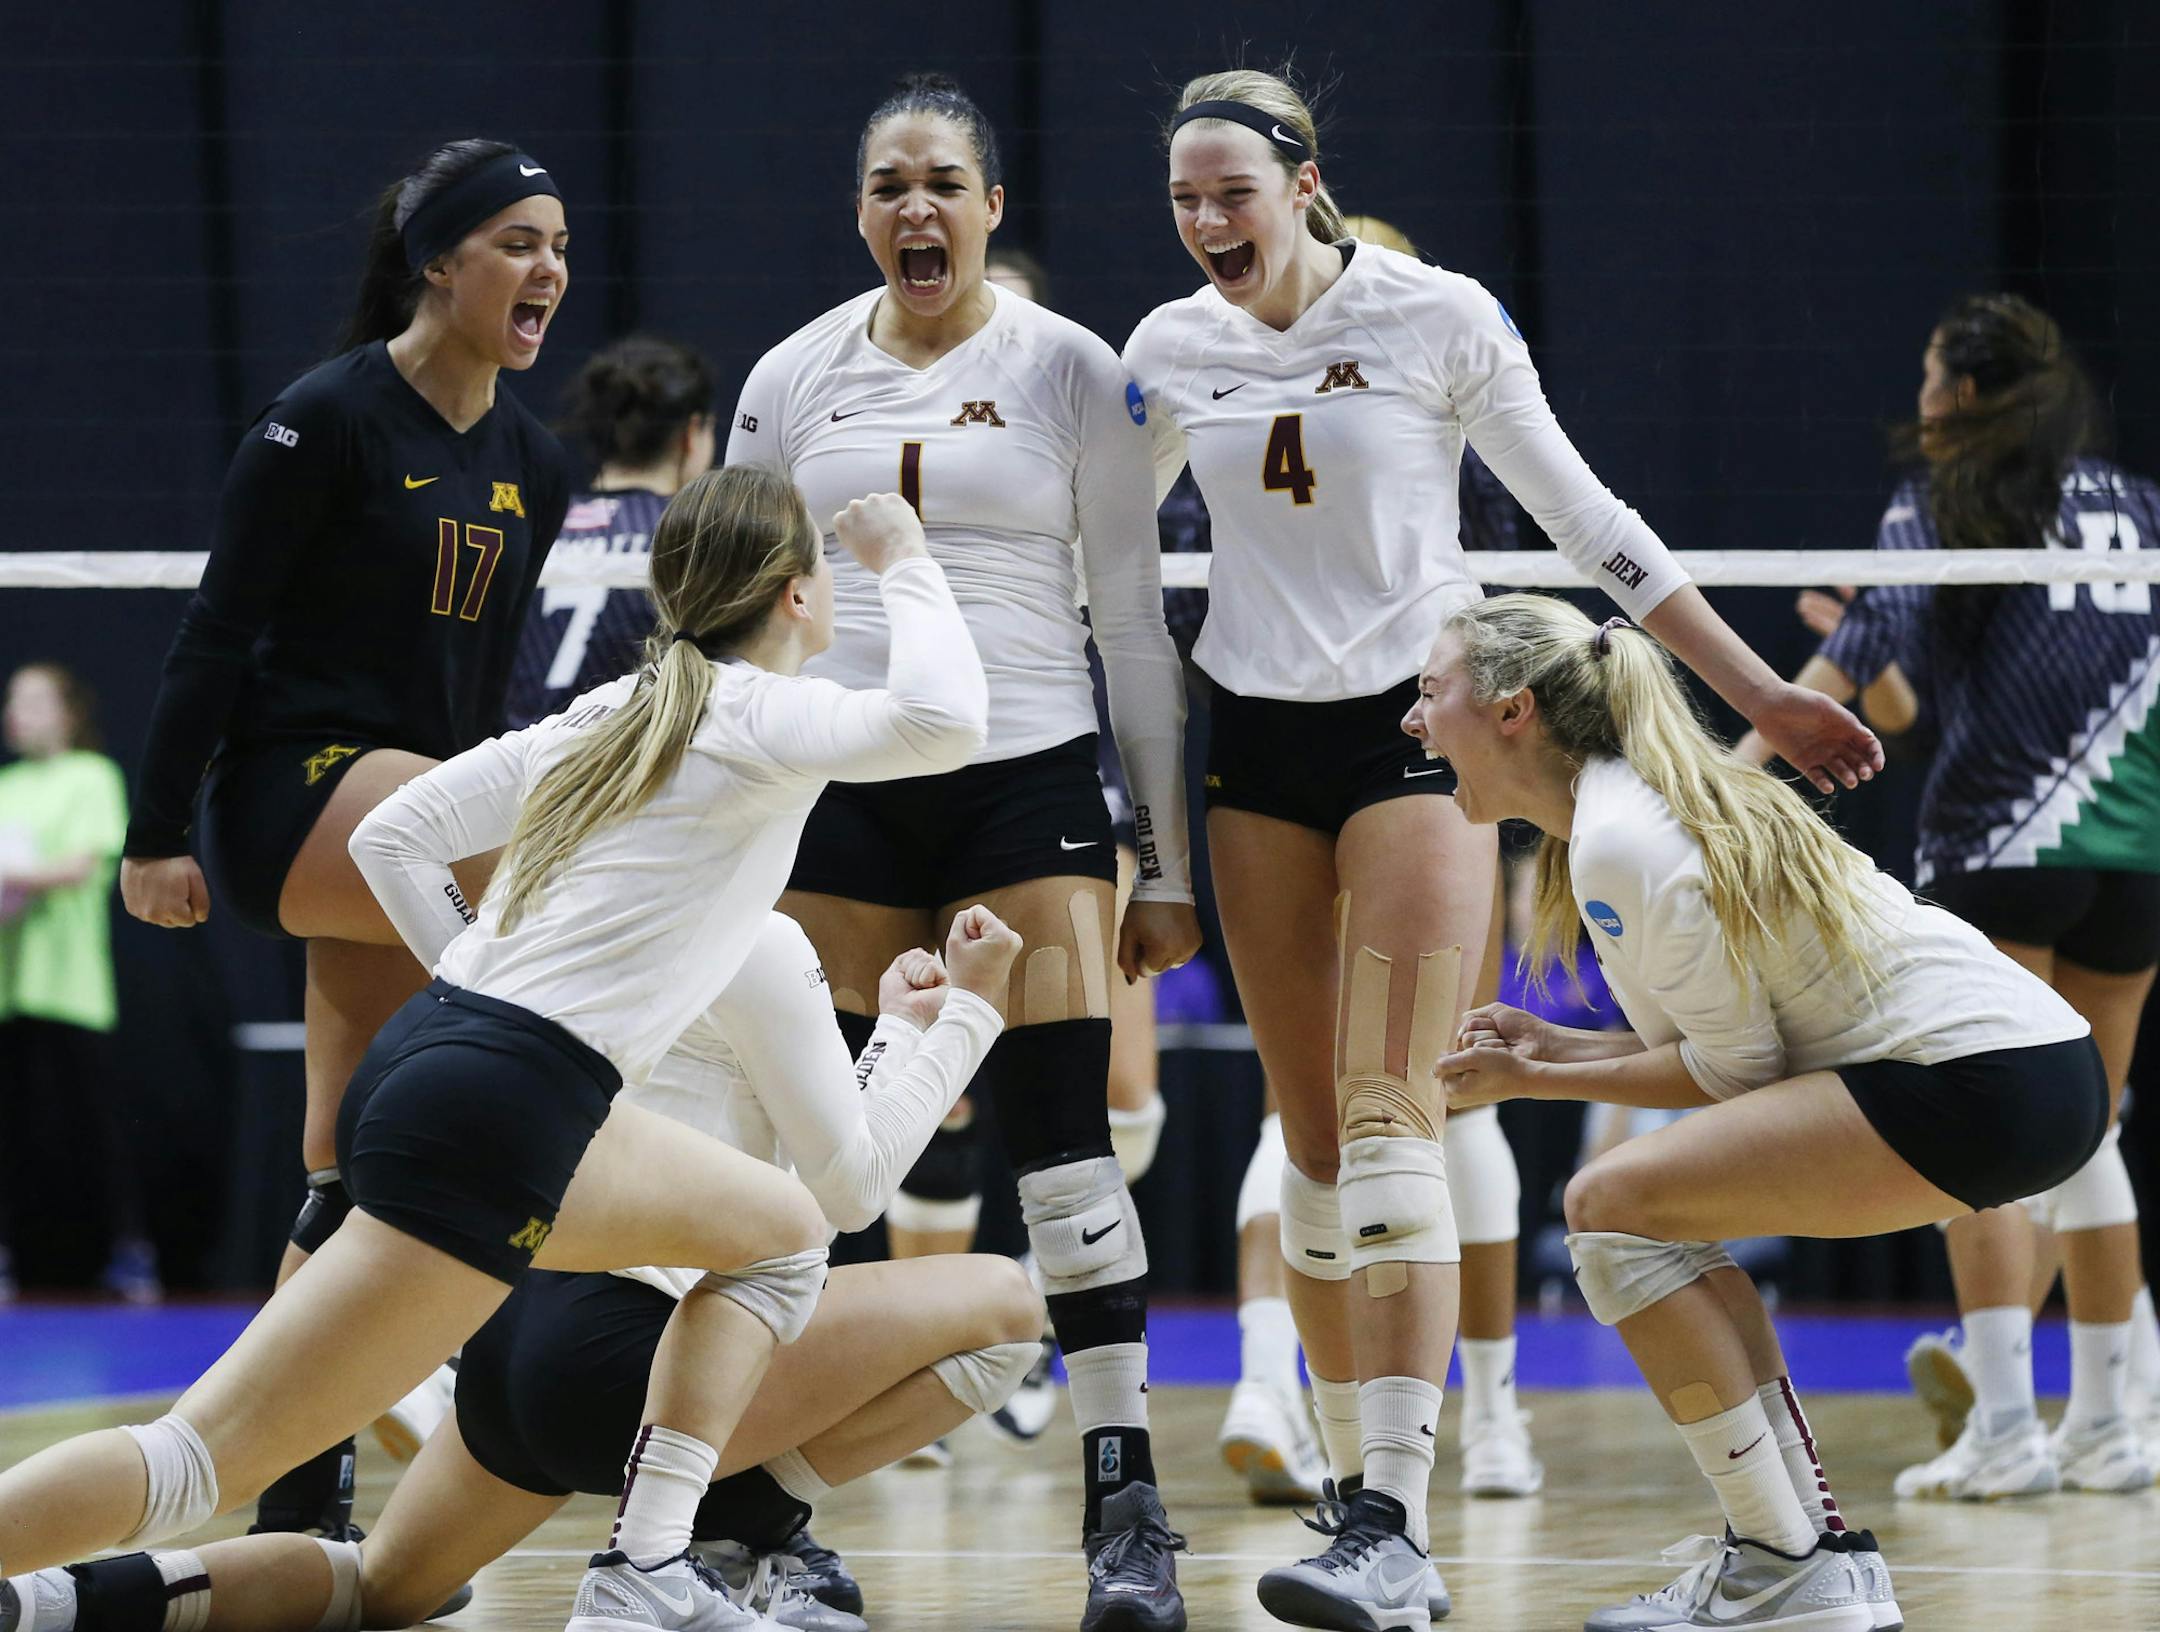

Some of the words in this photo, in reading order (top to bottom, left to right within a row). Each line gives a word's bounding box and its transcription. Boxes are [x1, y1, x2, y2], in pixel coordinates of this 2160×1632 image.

[1315, 361, 1369, 394] M
[950, 401, 1005, 428] M
[898, 440, 926, 523] 1
[1263, 412, 1316, 507] 4
[489, 481, 525, 519] M
[431, 517, 504, 622] 17
[1601, 551, 1649, 591] DEN
[541, 586, 609, 690] 7
